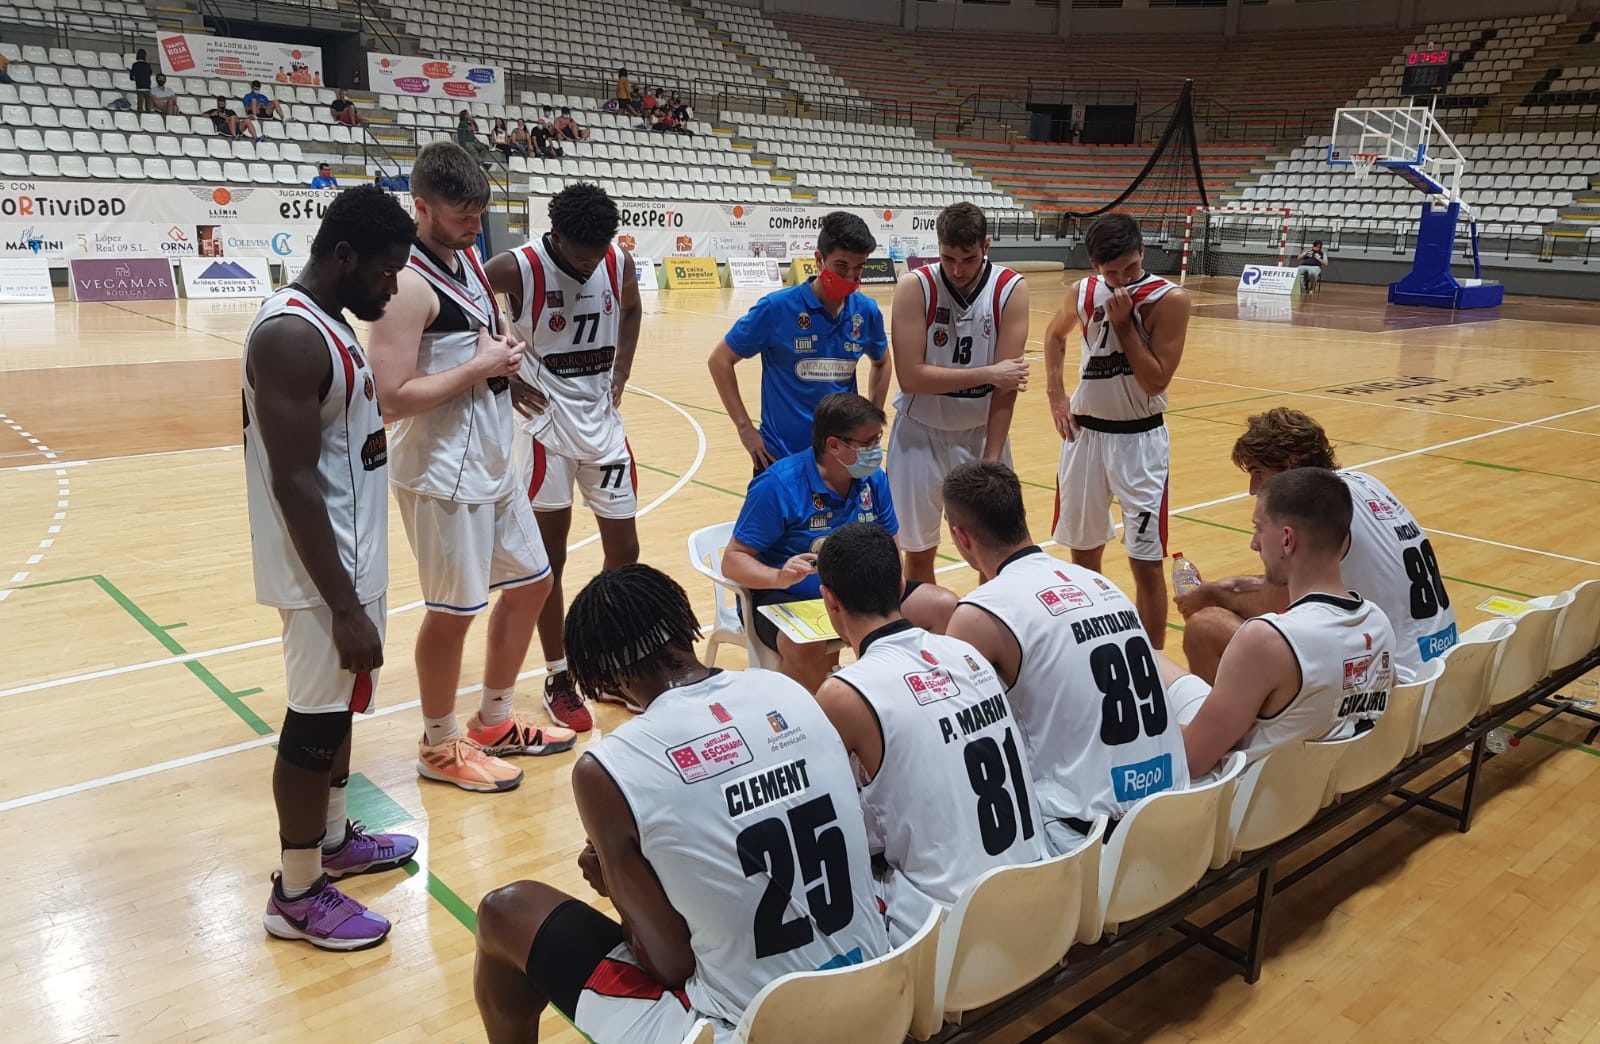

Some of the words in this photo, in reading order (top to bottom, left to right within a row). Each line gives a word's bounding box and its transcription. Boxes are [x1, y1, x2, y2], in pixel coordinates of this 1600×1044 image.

[11, 183, 35, 192] CON
[279, 190, 320, 198] JUGAMOS
[622, 201, 651, 210] JUGAMOS
[6, 241, 64, 252] MARTINI
[95, 233, 122, 245] López
[96, 244, 116, 253] Real
[161, 242, 194, 252] ORNA
[80, 278, 169, 289] VEGAMAR
[1262, 270, 1297, 279] REFITEL
[209, 286, 219, 294] 96
[219, 286, 236, 294] 213
[237, 286, 247, 294] 34
[248, 286, 257, 294] 31
[572, 313, 600, 345] 77
[952, 335, 974, 366] 13
[600, 464, 626, 489] 77
[1137, 511, 1151, 534] 7
[1089, 635, 1168, 747] 89
[938, 717, 958, 745] P.
[955, 693, 1008, 736] MARIN
[767, 726, 802, 745] Ajuntament
[701, 739, 743, 761] ESCENARIO
[725, 758, 810, 818] CLEMENT
[963, 727, 1035, 857] 81
[736, 793, 854, 959] 25
